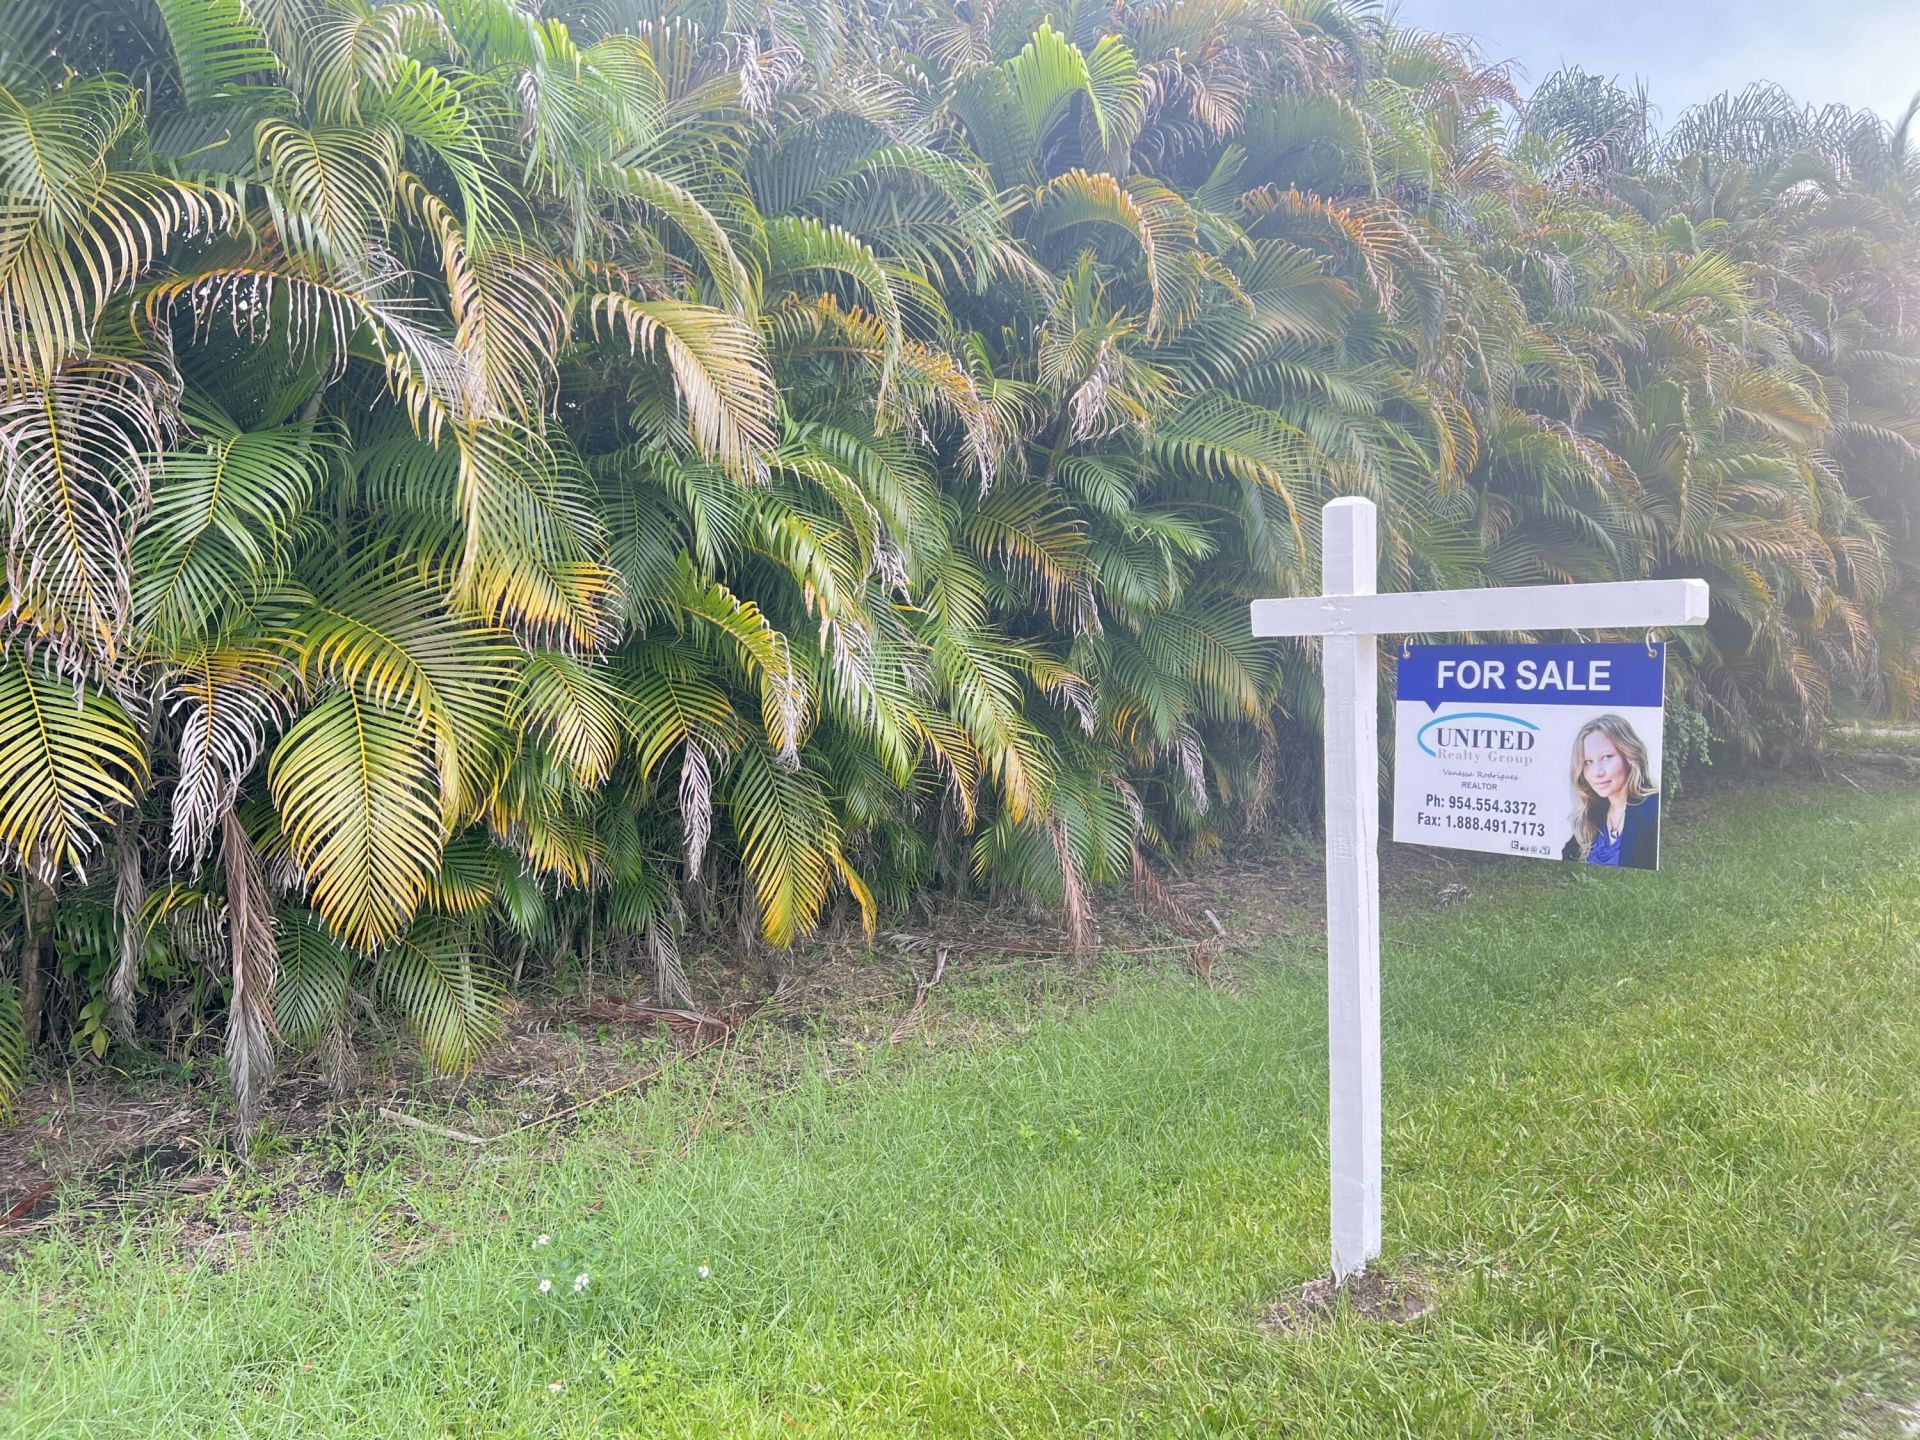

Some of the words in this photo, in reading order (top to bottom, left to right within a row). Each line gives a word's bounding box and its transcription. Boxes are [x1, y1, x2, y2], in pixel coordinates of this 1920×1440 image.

[1437, 660, 1506, 689] FOR
[1516, 660, 1611, 691] SALE
[1436, 727, 1535, 751] UNITED
[1438, 748, 1481, 764] Realty
[1488, 751, 1533, 767] Group
[1442, 768, 1475, 778] Vanessa
[1461, 781, 1498, 791] REALTOR
[1426, 793, 1445, 809] Ph:
[1449, 795, 1537, 816] 954.554.3372
[1417, 812, 1441, 827] Fax:
[1446, 814, 1545, 837] 1.888.491.7173
